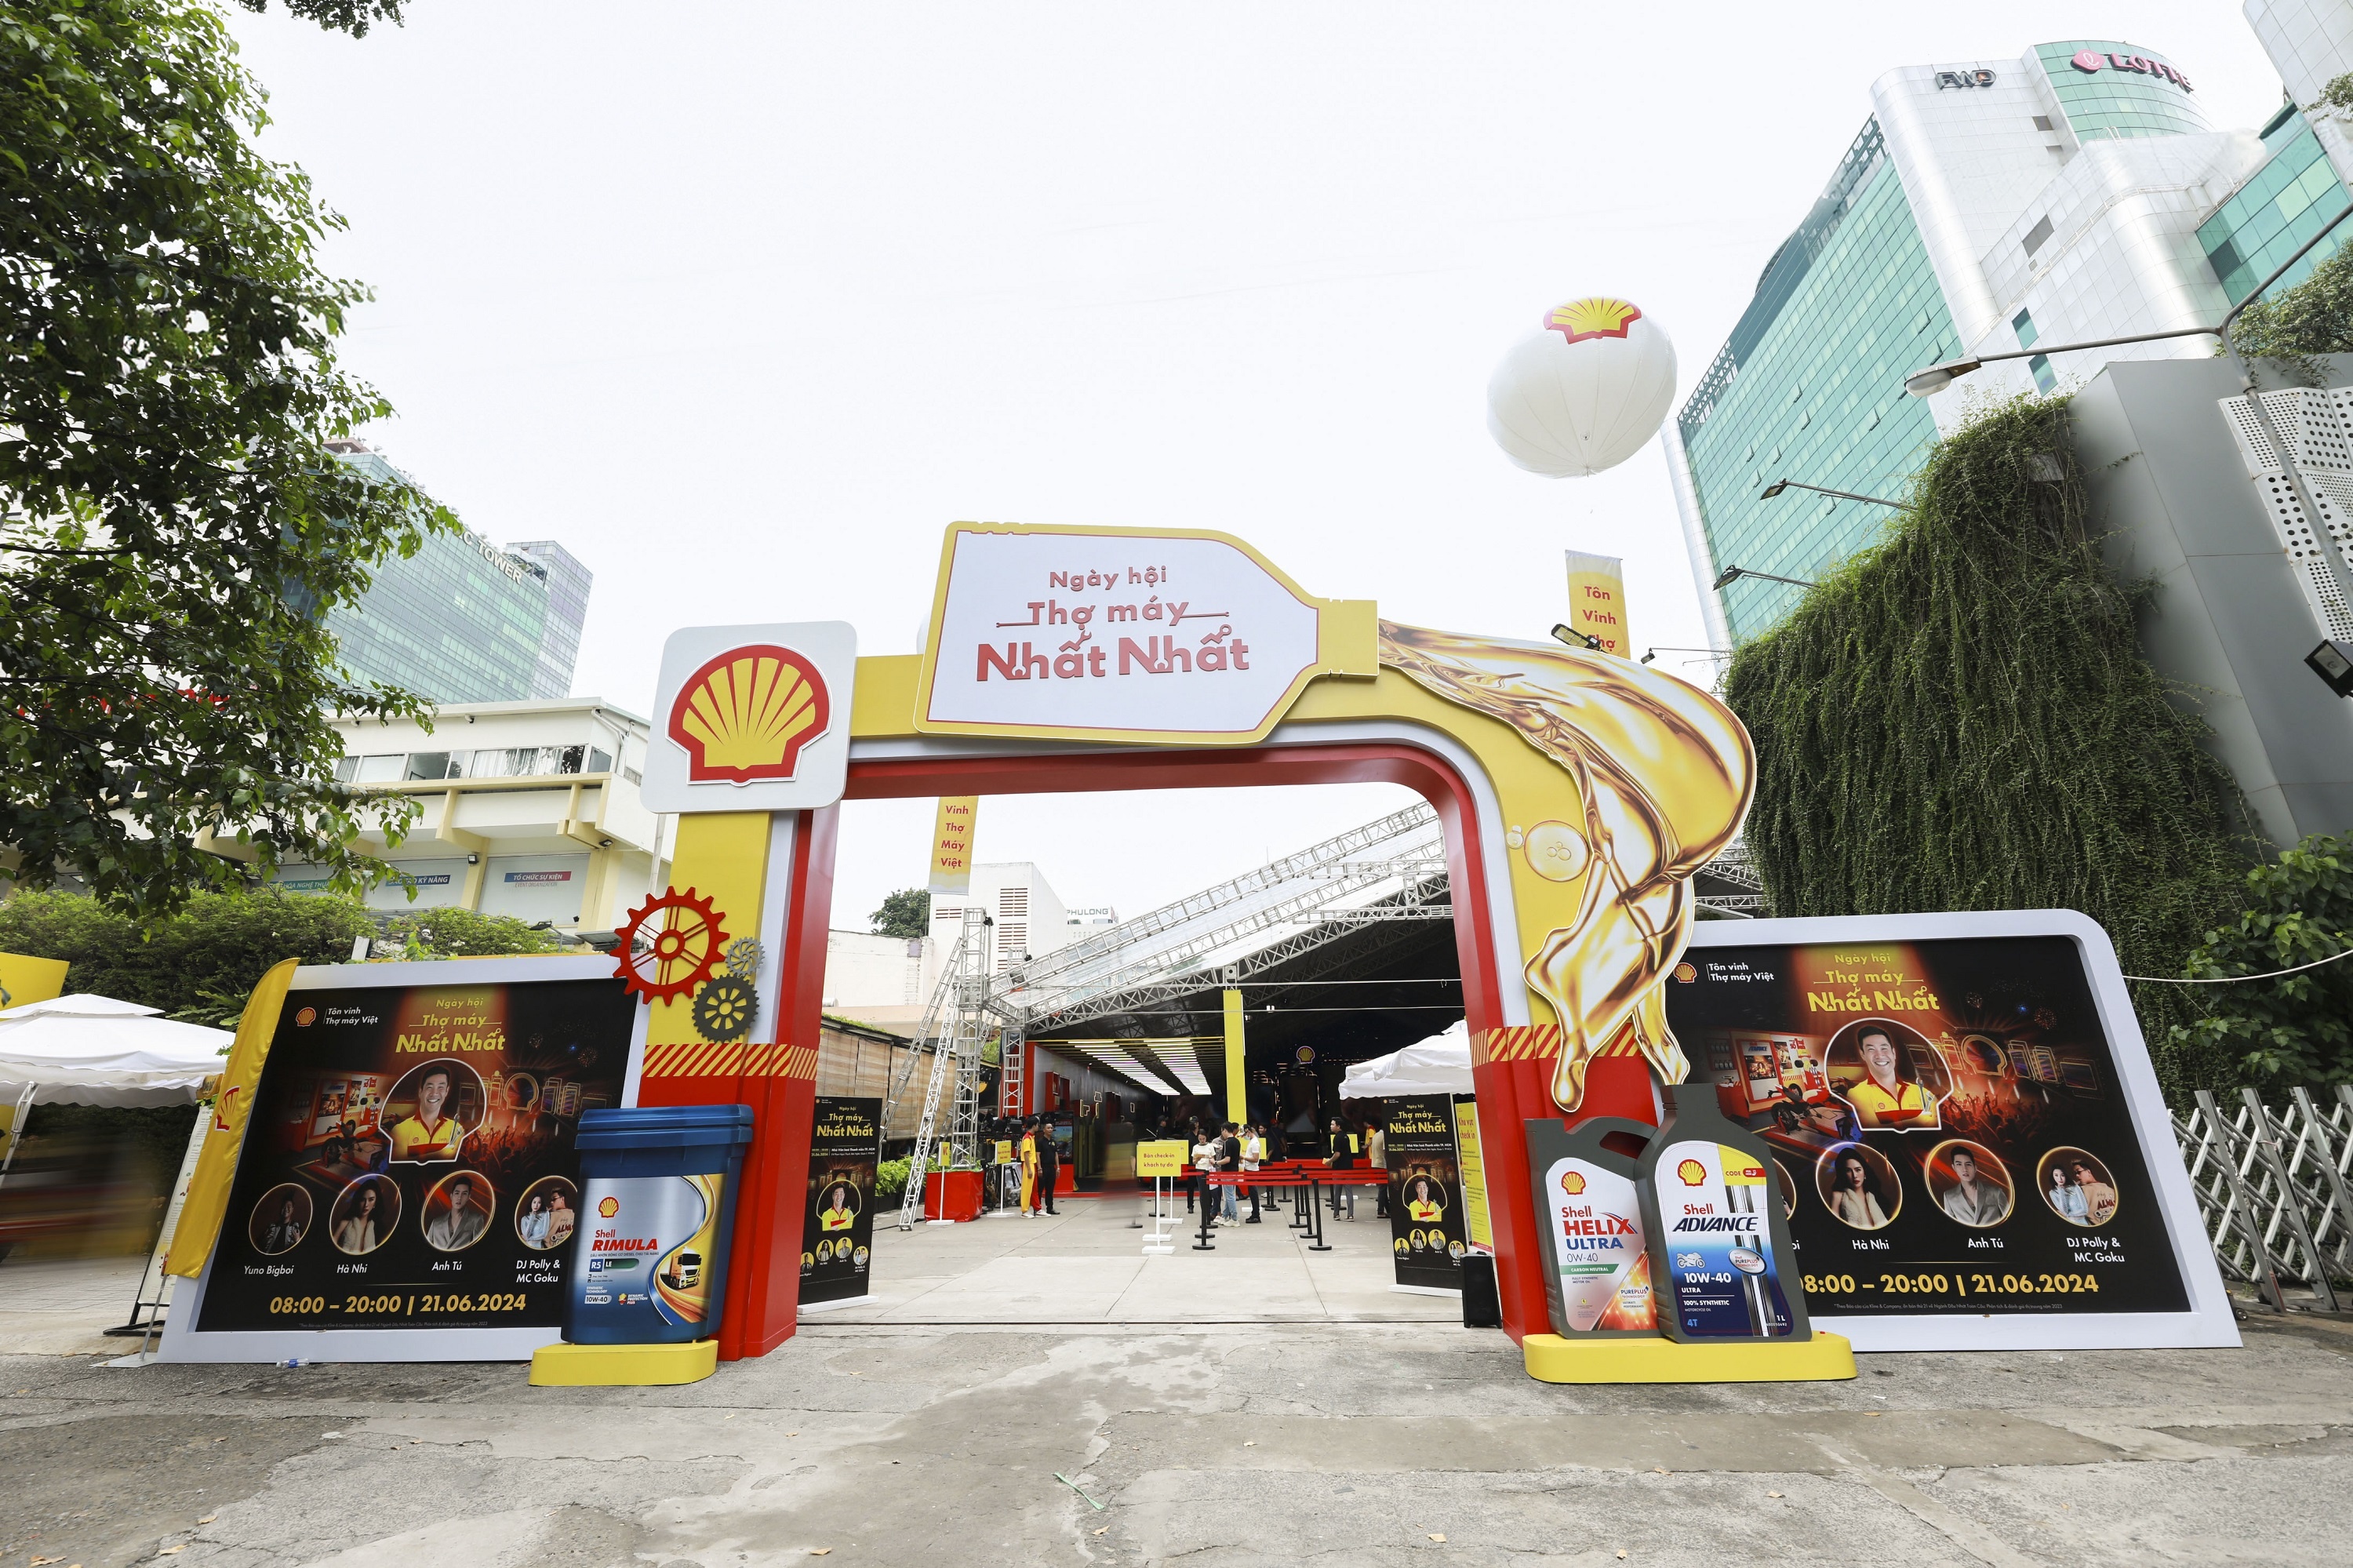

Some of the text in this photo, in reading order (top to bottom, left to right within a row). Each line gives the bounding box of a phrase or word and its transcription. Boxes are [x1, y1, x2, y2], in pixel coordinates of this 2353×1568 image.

[1935, 69, 1997, 90] FWD
[2108, 53, 2195, 94] LOTTE
[477, 540, 522, 585] TOWER
[1049, 566, 1166, 591] Ngày hội
[1584, 586, 1610, 600] Tôn
[1027, 595, 1190, 630] Thợ máy
[1582, 609, 1617, 625] Vinh
[1588, 634, 1616, 652] hợ
[976, 630, 1106, 682] Nhất
[945, 806, 969, 814] Vinh
[946, 822, 965, 834] Thợ
[940, 840, 965, 852] Máy
[940, 857, 962, 868] Việt
[427, 875, 448, 884] NĂNG
[1835, 953, 1891, 966] Ngày hội
[1708, 962, 1749, 971] Tôn vinh
[1711, 973, 1774, 983] Thợ máy Việt
[1825, 970, 1904, 986] Thợ máy
[435, 998, 483, 1010] Ngày hội
[1807, 986, 1873, 1013] Nhất
[325, 1016, 379, 1026] Thợ máy Việt
[422, 1013, 488, 1028] Thợ máy
[395, 1028, 449, 1053] Nhất
[829, 1113, 863, 1122] Thợ máy
[1398, 1110, 1432, 1120] Thợ máy
[816, 1122, 846, 1137] Nhất
[1389, 1119, 1417, 1133] Nhất
[1562, 1206, 1592, 1217] Shell
[1683, 1203, 1714, 1214] Shell
[1562, 1215, 1637, 1235] HELIX
[1672, 1217, 1758, 1232] ADVANCE
[595, 1229, 616, 1238] Shell
[591, 1239, 658, 1251] RIMULA
[1566, 1237, 1624, 1250] ULTRA
[1852, 1239, 1890, 1250] Hà Nhi
[1967, 1237, 2004, 1249] Anh Tú
[2066, 1236, 2121, 1250] DJ Polly &
[1567, 1253, 1598, 1263] 0W-40
[2075, 1251, 2126, 1263] MC Goku
[244, 1264, 294, 1277] Yuno Bigboi
[336, 1264, 368, 1274] Hà Nhi
[431, 1259, 463, 1271] Anh Tú
[516, 1259, 561, 1272] DJ Polly &
[516, 1272, 559, 1283] MC Goku
[1684, 1272, 1732, 1283] 10W-40
[1880, 1274, 1949, 1293] 20:00
[1971, 1273, 2100, 1293] 21.06.2024
[269, 1296, 324, 1314] 08:00
[344, 1294, 402, 1313] 20:00
[420, 1293, 526, 1312] 21.06.2024
